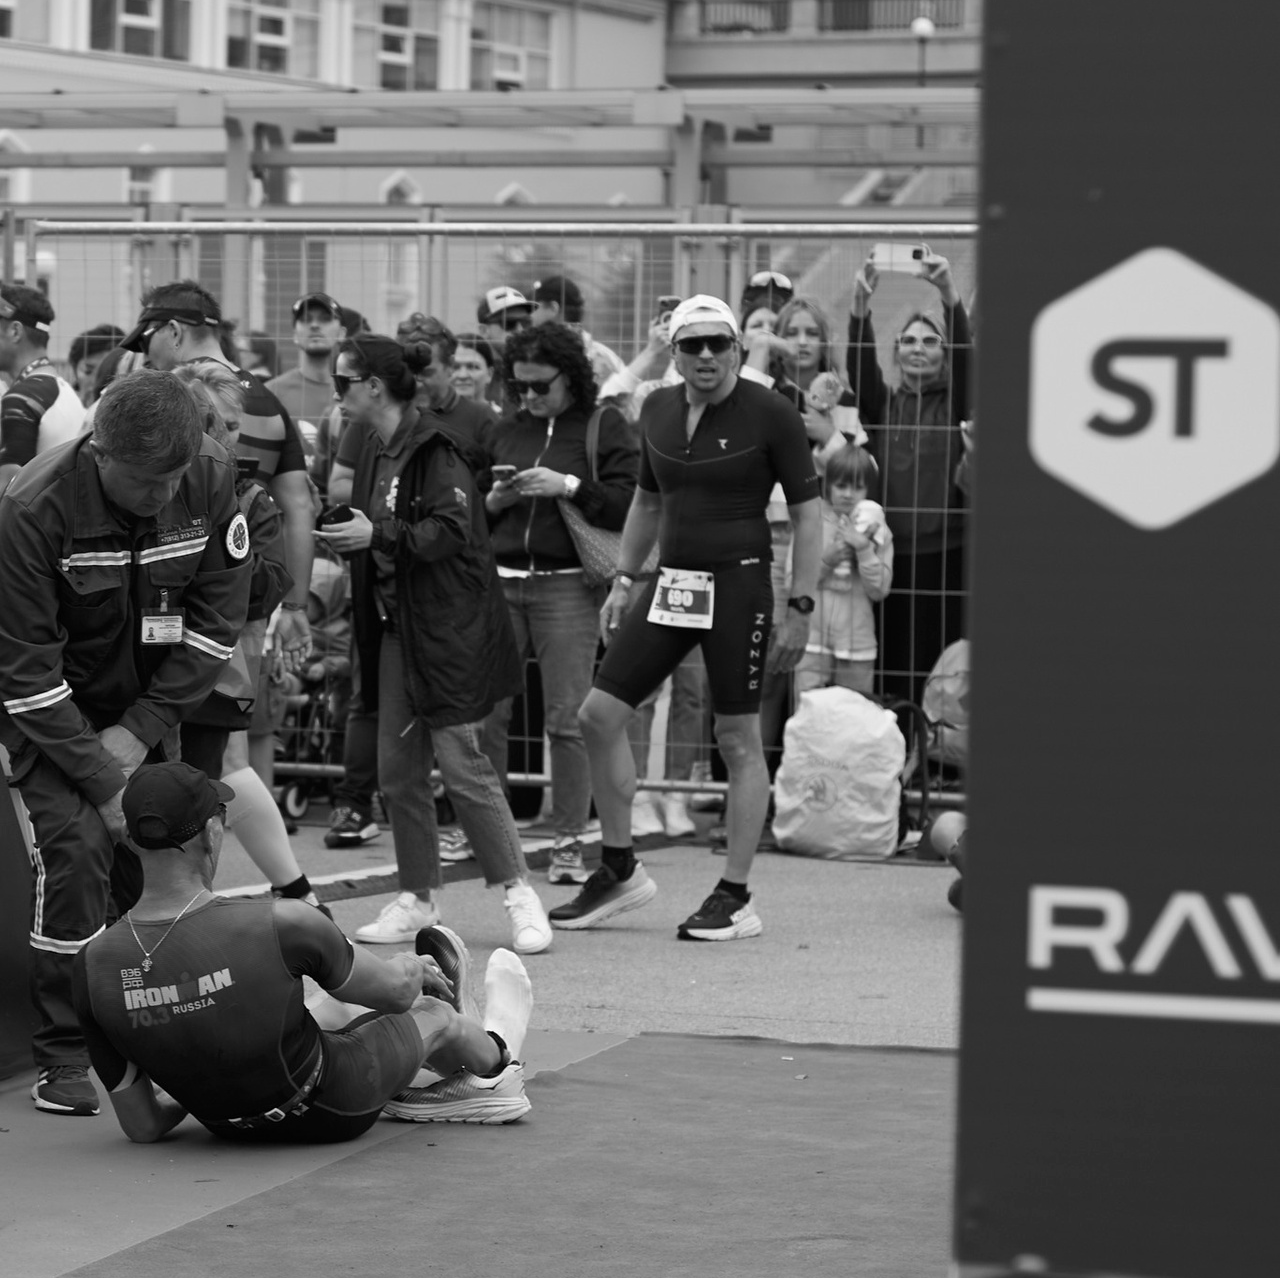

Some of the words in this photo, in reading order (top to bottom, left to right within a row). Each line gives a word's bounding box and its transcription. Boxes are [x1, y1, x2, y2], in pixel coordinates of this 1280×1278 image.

[1086, 337, 1230, 440] ST
[748, 612, 766, 690] RYZON
[120, 968, 142, 979] ВЭБ
[127, 1006, 171, 1029] 70.3
[172, 997, 216, 1015] RUSSIA
